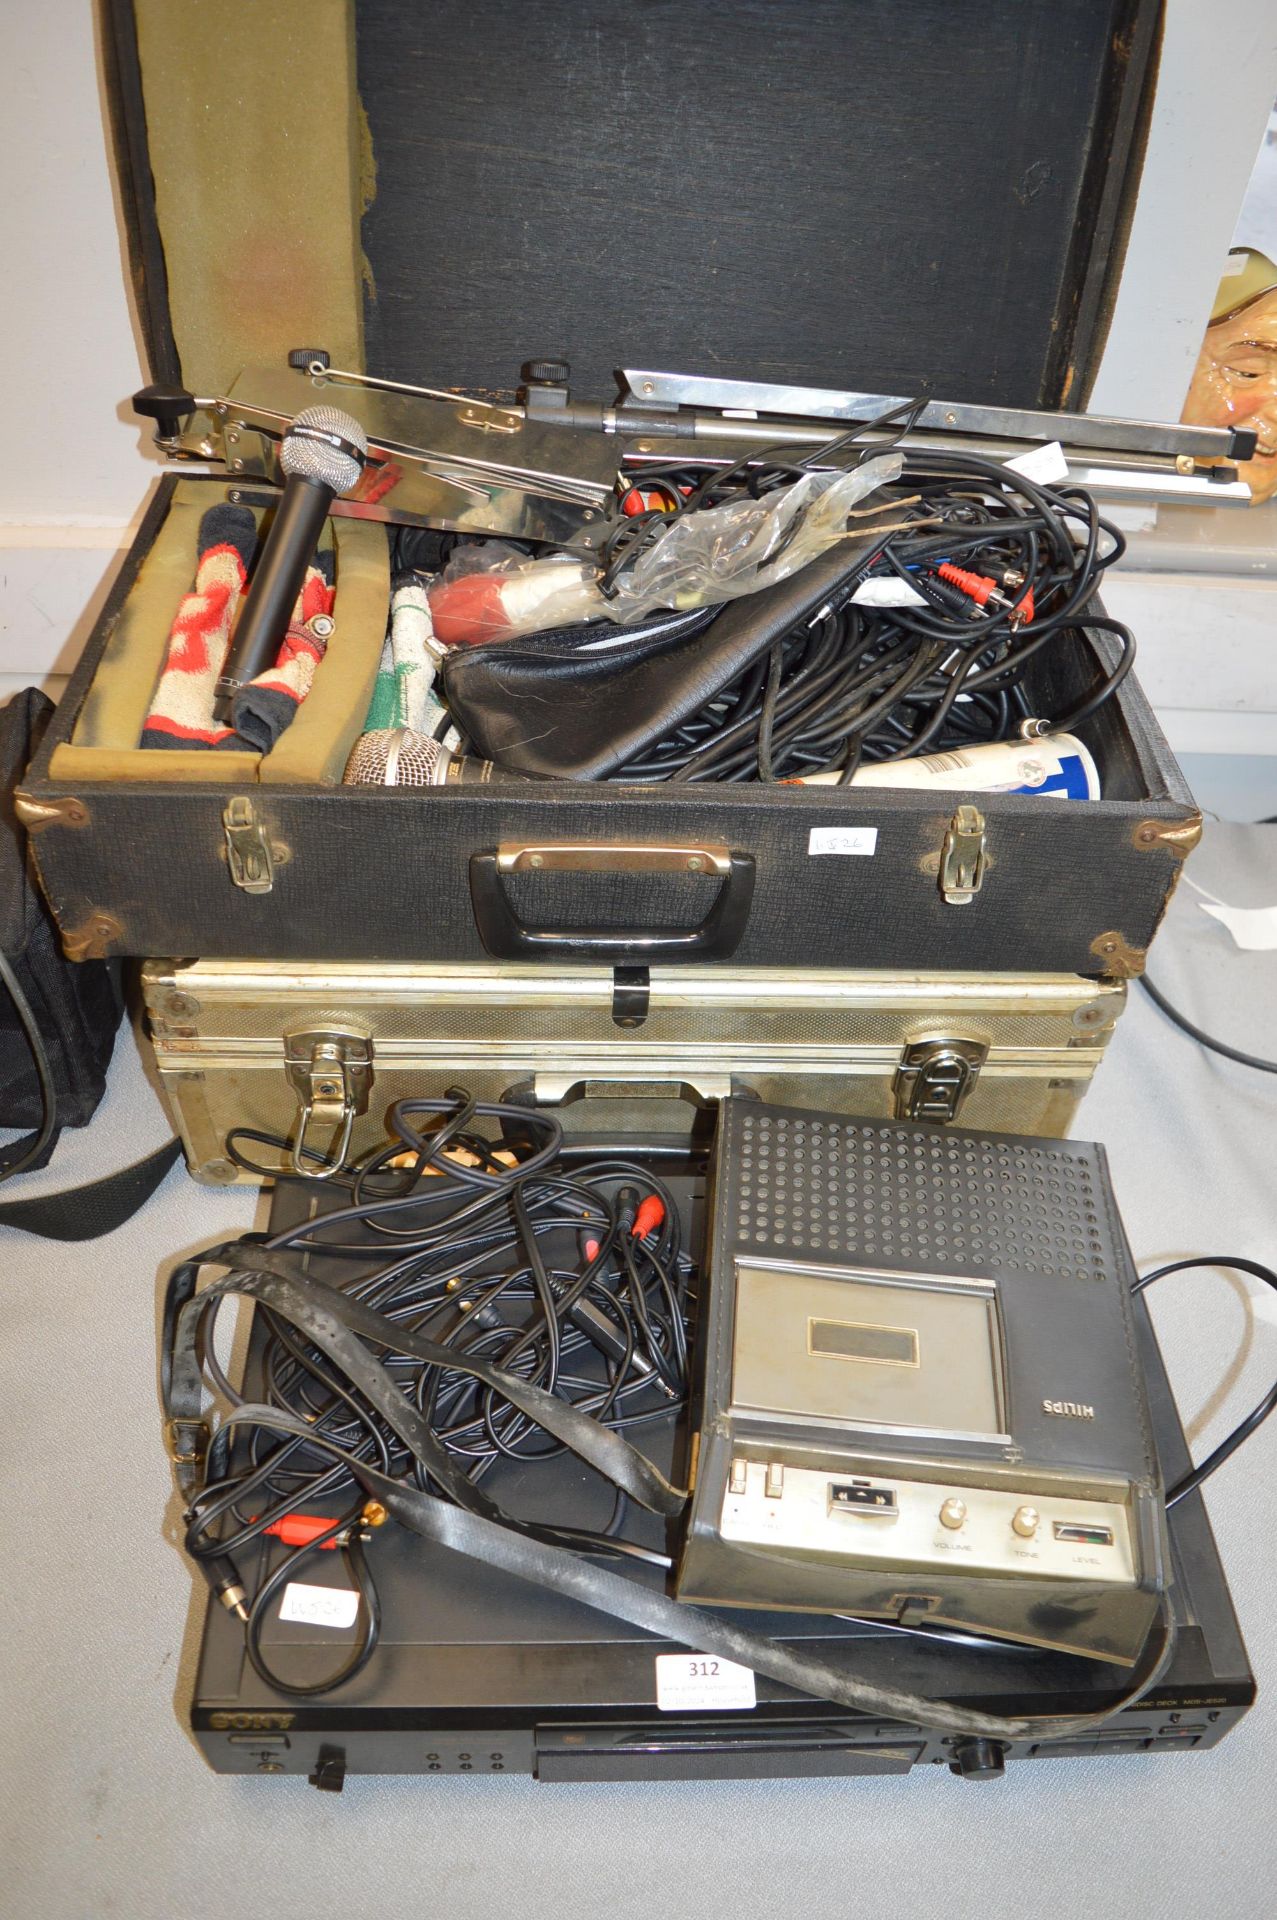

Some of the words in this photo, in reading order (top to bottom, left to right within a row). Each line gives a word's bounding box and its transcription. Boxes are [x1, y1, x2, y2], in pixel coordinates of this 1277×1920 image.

[932, 1541, 973, 1552] VOLUME
[1014, 1549, 1040, 1559] TONE
[1071, 1556, 1102, 1566] LEVEL
[689, 1661, 720, 1676] 312
[209, 1711, 296, 1730] SONY
